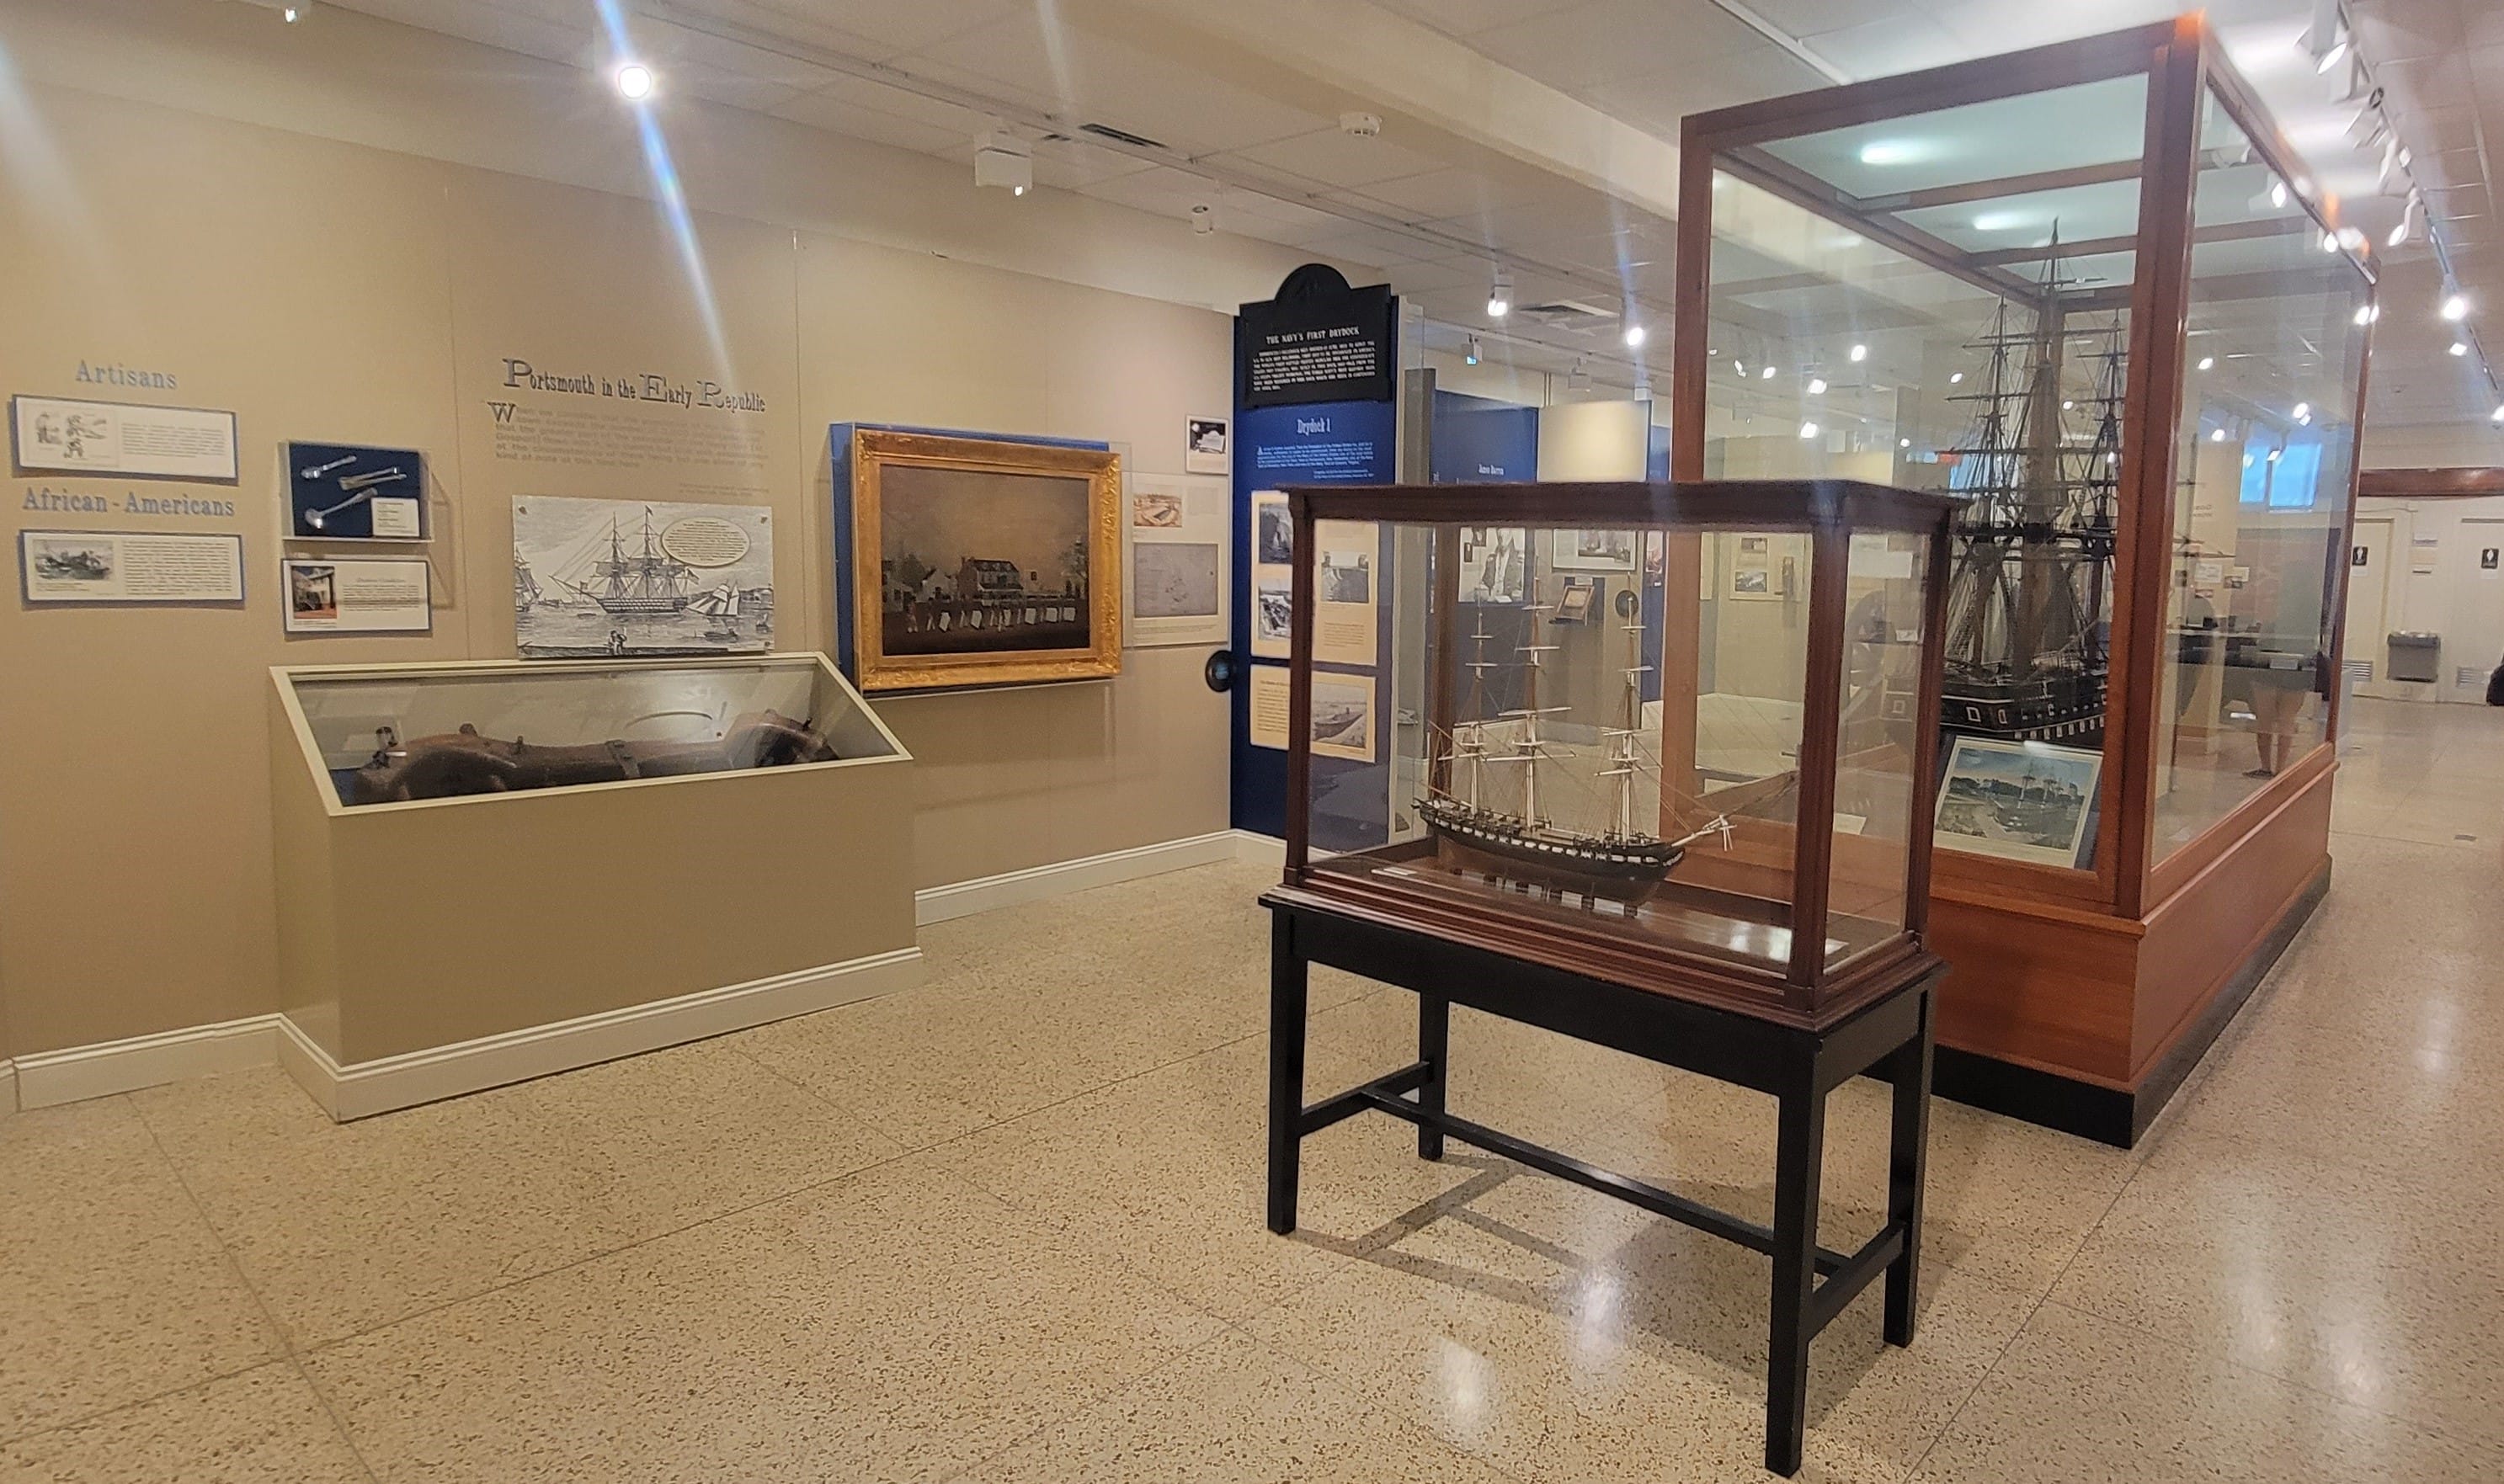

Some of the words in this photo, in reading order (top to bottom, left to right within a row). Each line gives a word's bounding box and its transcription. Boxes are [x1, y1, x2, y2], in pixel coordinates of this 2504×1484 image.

[1307, 330, 1326, 341] FIRST
[1329, 326, 1360, 338] DRYDOCK
[75, 359, 178, 389] Artisans
[502, 358, 594, 396] Portsmouth
[602, 377, 613, 396] in
[618, 379, 636, 400] the
[639, 374, 692, 409] Early
[696, 380, 766, 413] Republic
[1297, 418, 1325, 436] Drydock
